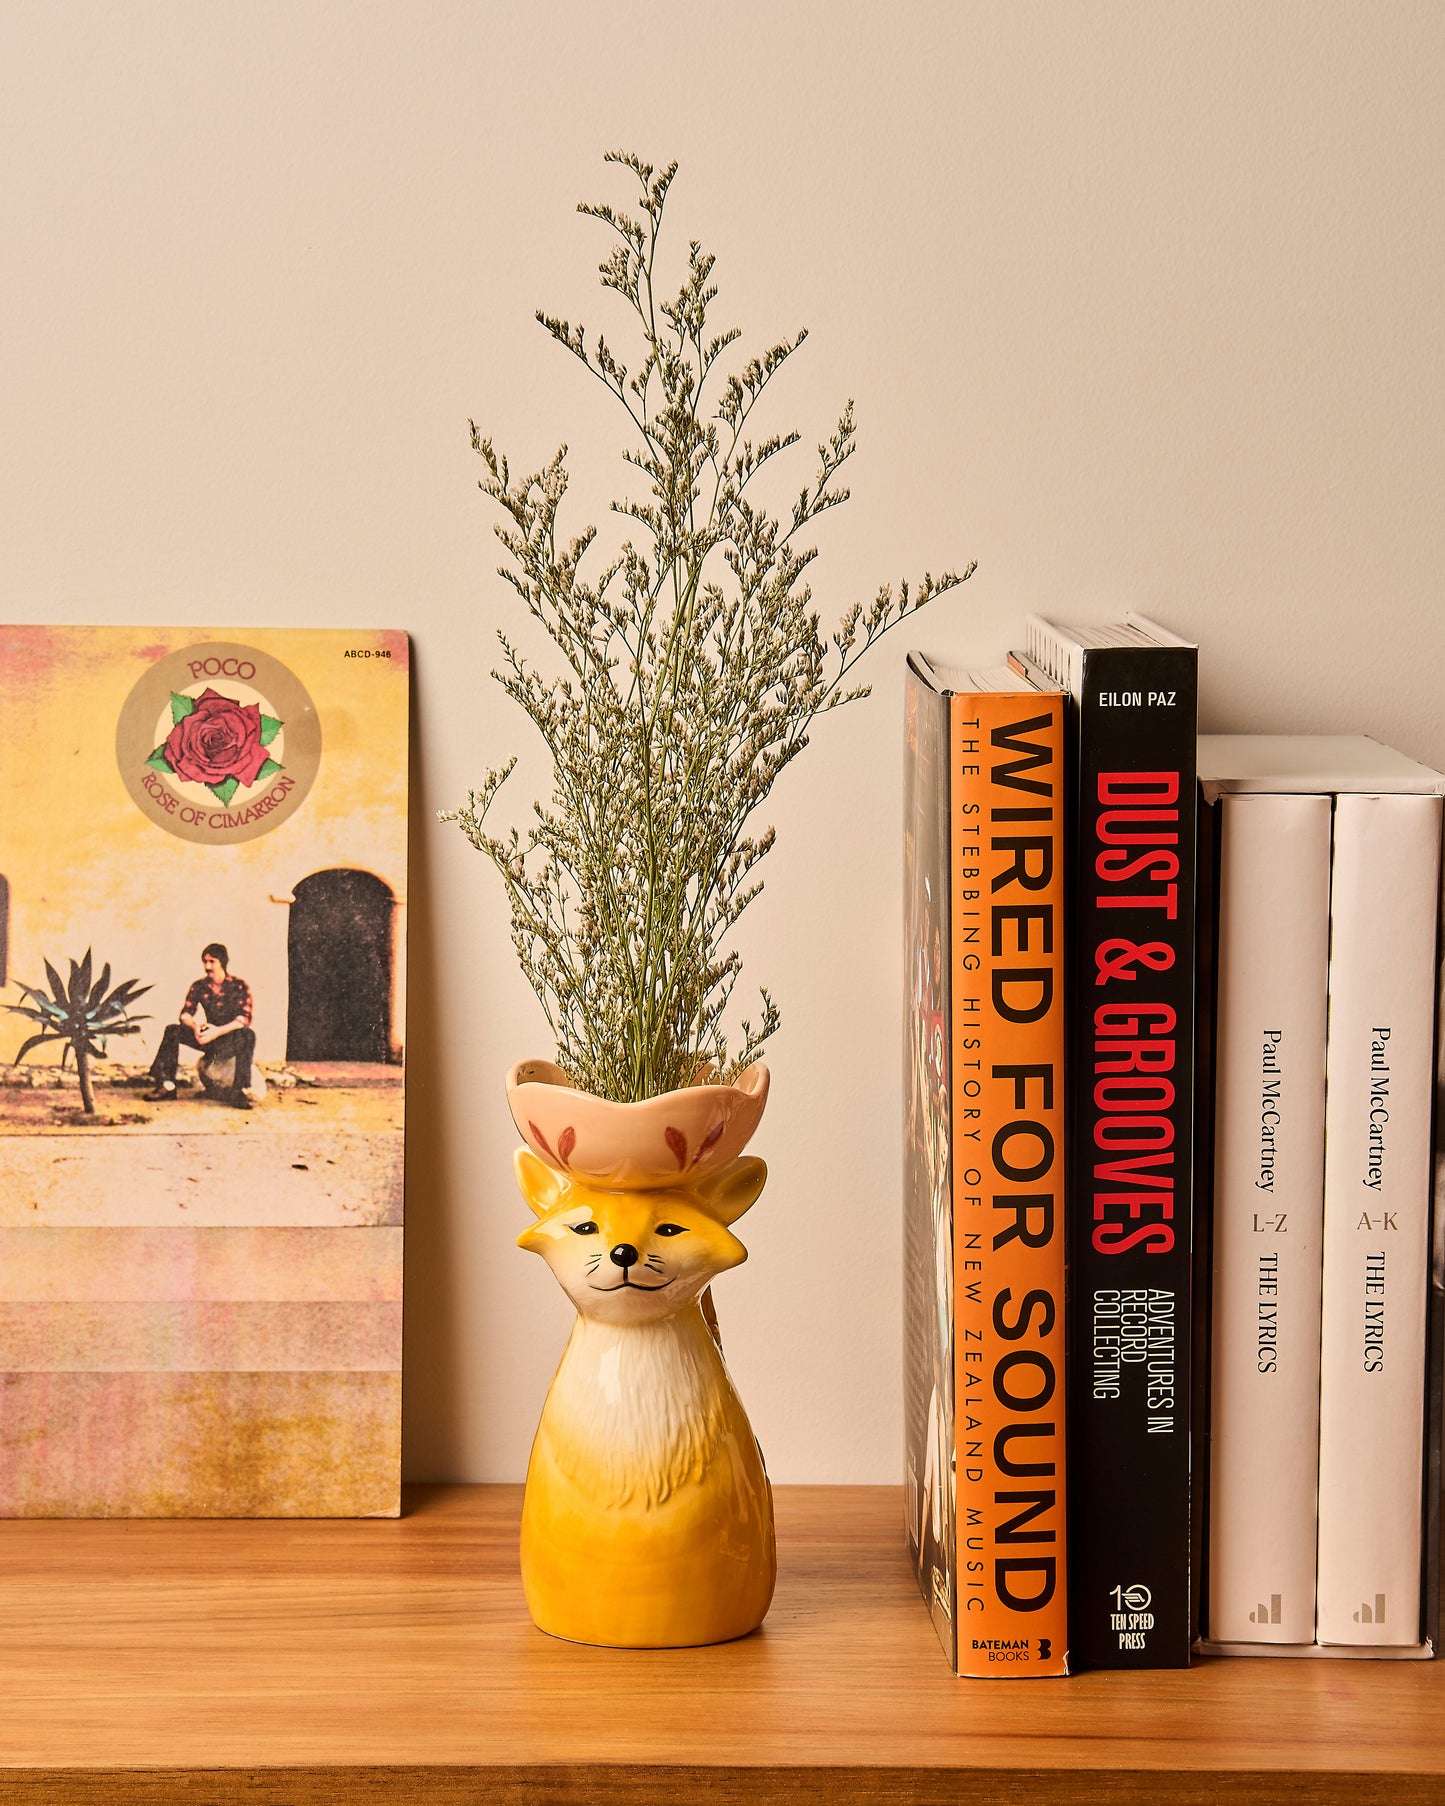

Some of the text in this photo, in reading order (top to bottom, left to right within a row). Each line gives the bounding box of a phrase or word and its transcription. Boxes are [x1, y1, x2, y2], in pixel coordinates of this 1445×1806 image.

[187, 658, 256, 680] POCO
[344, 649, 392, 659] ABCD-946
[1100, 692, 1176, 706] EILON PAZ
[141, 772, 296, 829] ROSE OF CIMARRON
[1092, 772, 1179, 1254] DUST & GROOVES
[1255, 1030, 1281, 1193] Paul McCartney
[1364, 1028, 1390, 1192] Paul McCartney
[962, 718, 985, 1611] THE STEBBING HISTORY OF NEW ZEALAND MUSIC
[991, 713, 1056, 1612] WIRED FOR SOUND
[1253, 1213, 1288, 1234] L-Z
[1357, 1212, 1398, 1230] A-K
[1094, 1290, 1120, 1398] COLLECTING
[1120, 1289, 1148, 1363] RECORD
[1258, 1253, 1277, 1373] THE LYRICS
[1364, 1252, 1385, 1372] THE LYRICS
[1147, 1289, 1174, 1432] ADVENTURES IN
[972, 1639, 1029, 1650] BATEMAN
[1111, 1613, 1154, 1630] TEN SPEED
[1119, 1633, 1145, 1649] PRESS
[988, 1651, 1030, 1662] BOOKS
